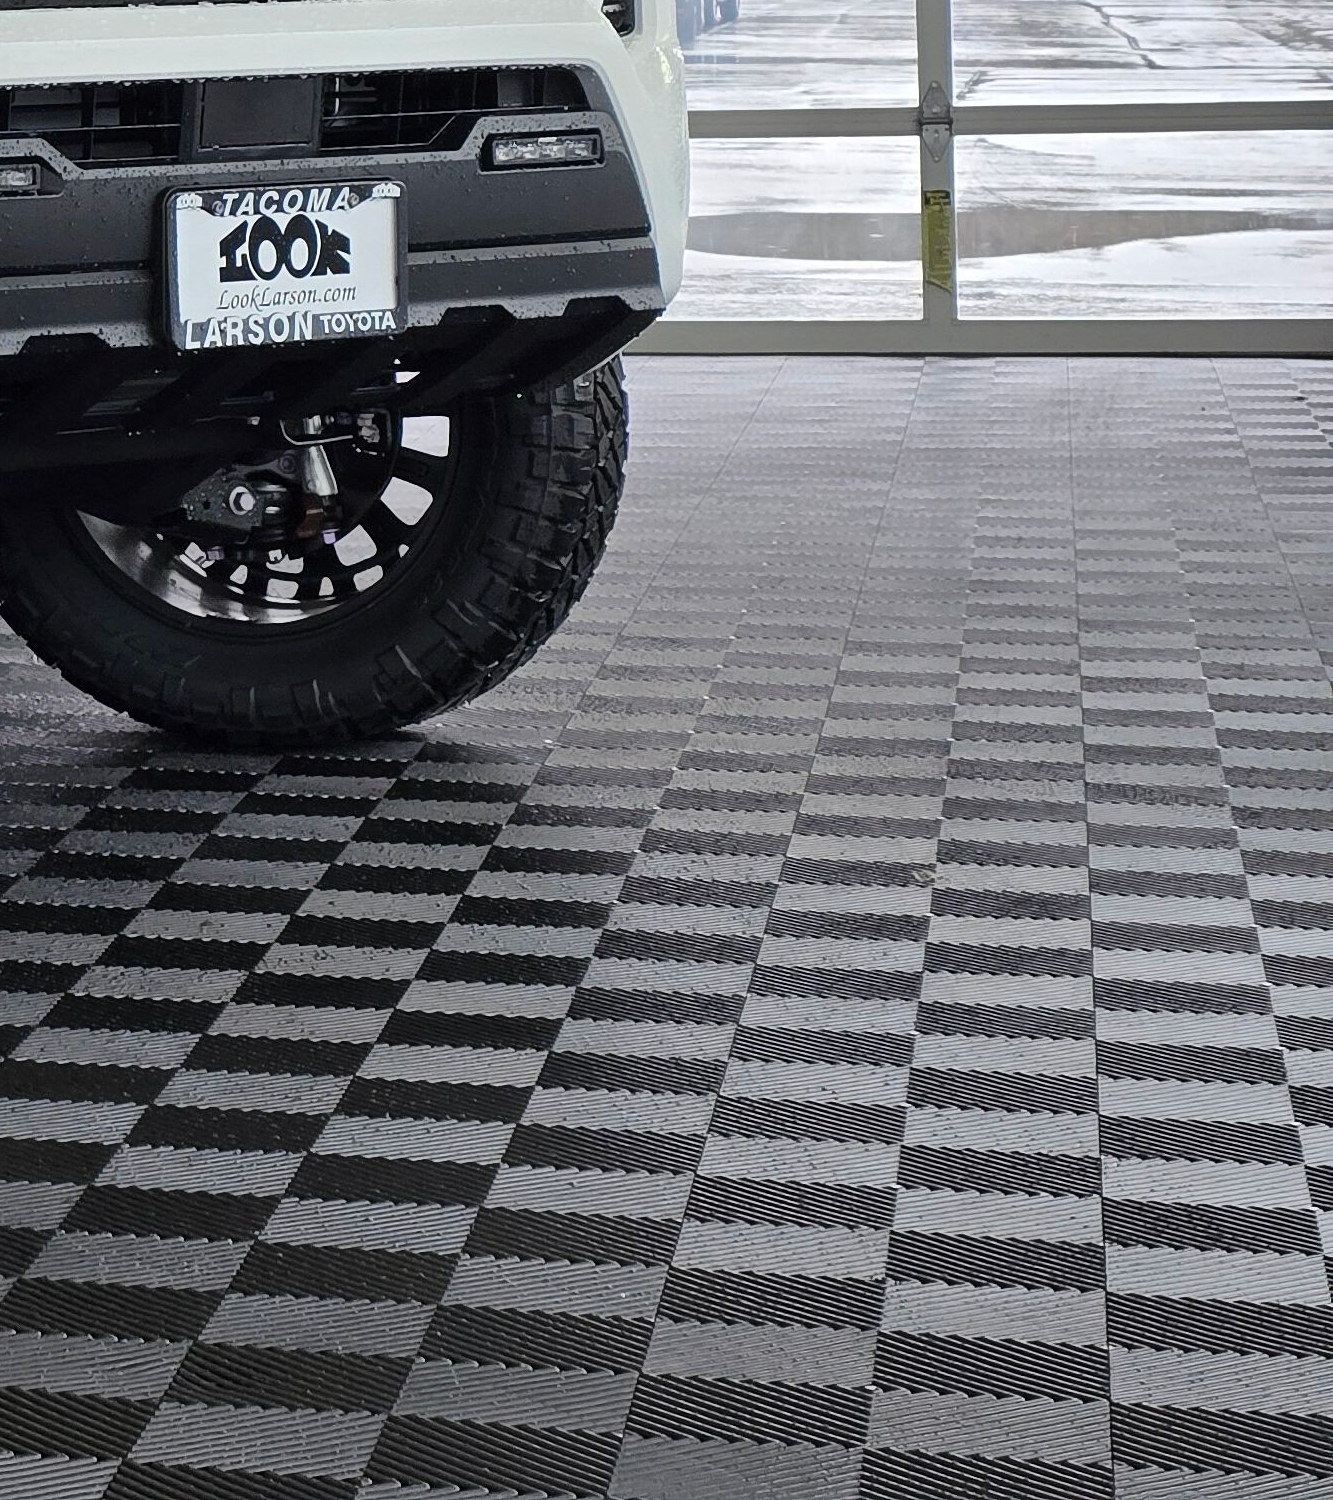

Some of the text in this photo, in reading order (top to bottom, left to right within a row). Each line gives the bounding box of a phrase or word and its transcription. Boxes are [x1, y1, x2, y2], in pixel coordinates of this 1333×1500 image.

[222, 186, 351, 217] TACOMA
[219, 213, 351, 283] LOOK
[216, 285, 357, 312] LookLarson.com
[185, 311, 397, 350] LARSON TOYOTA
